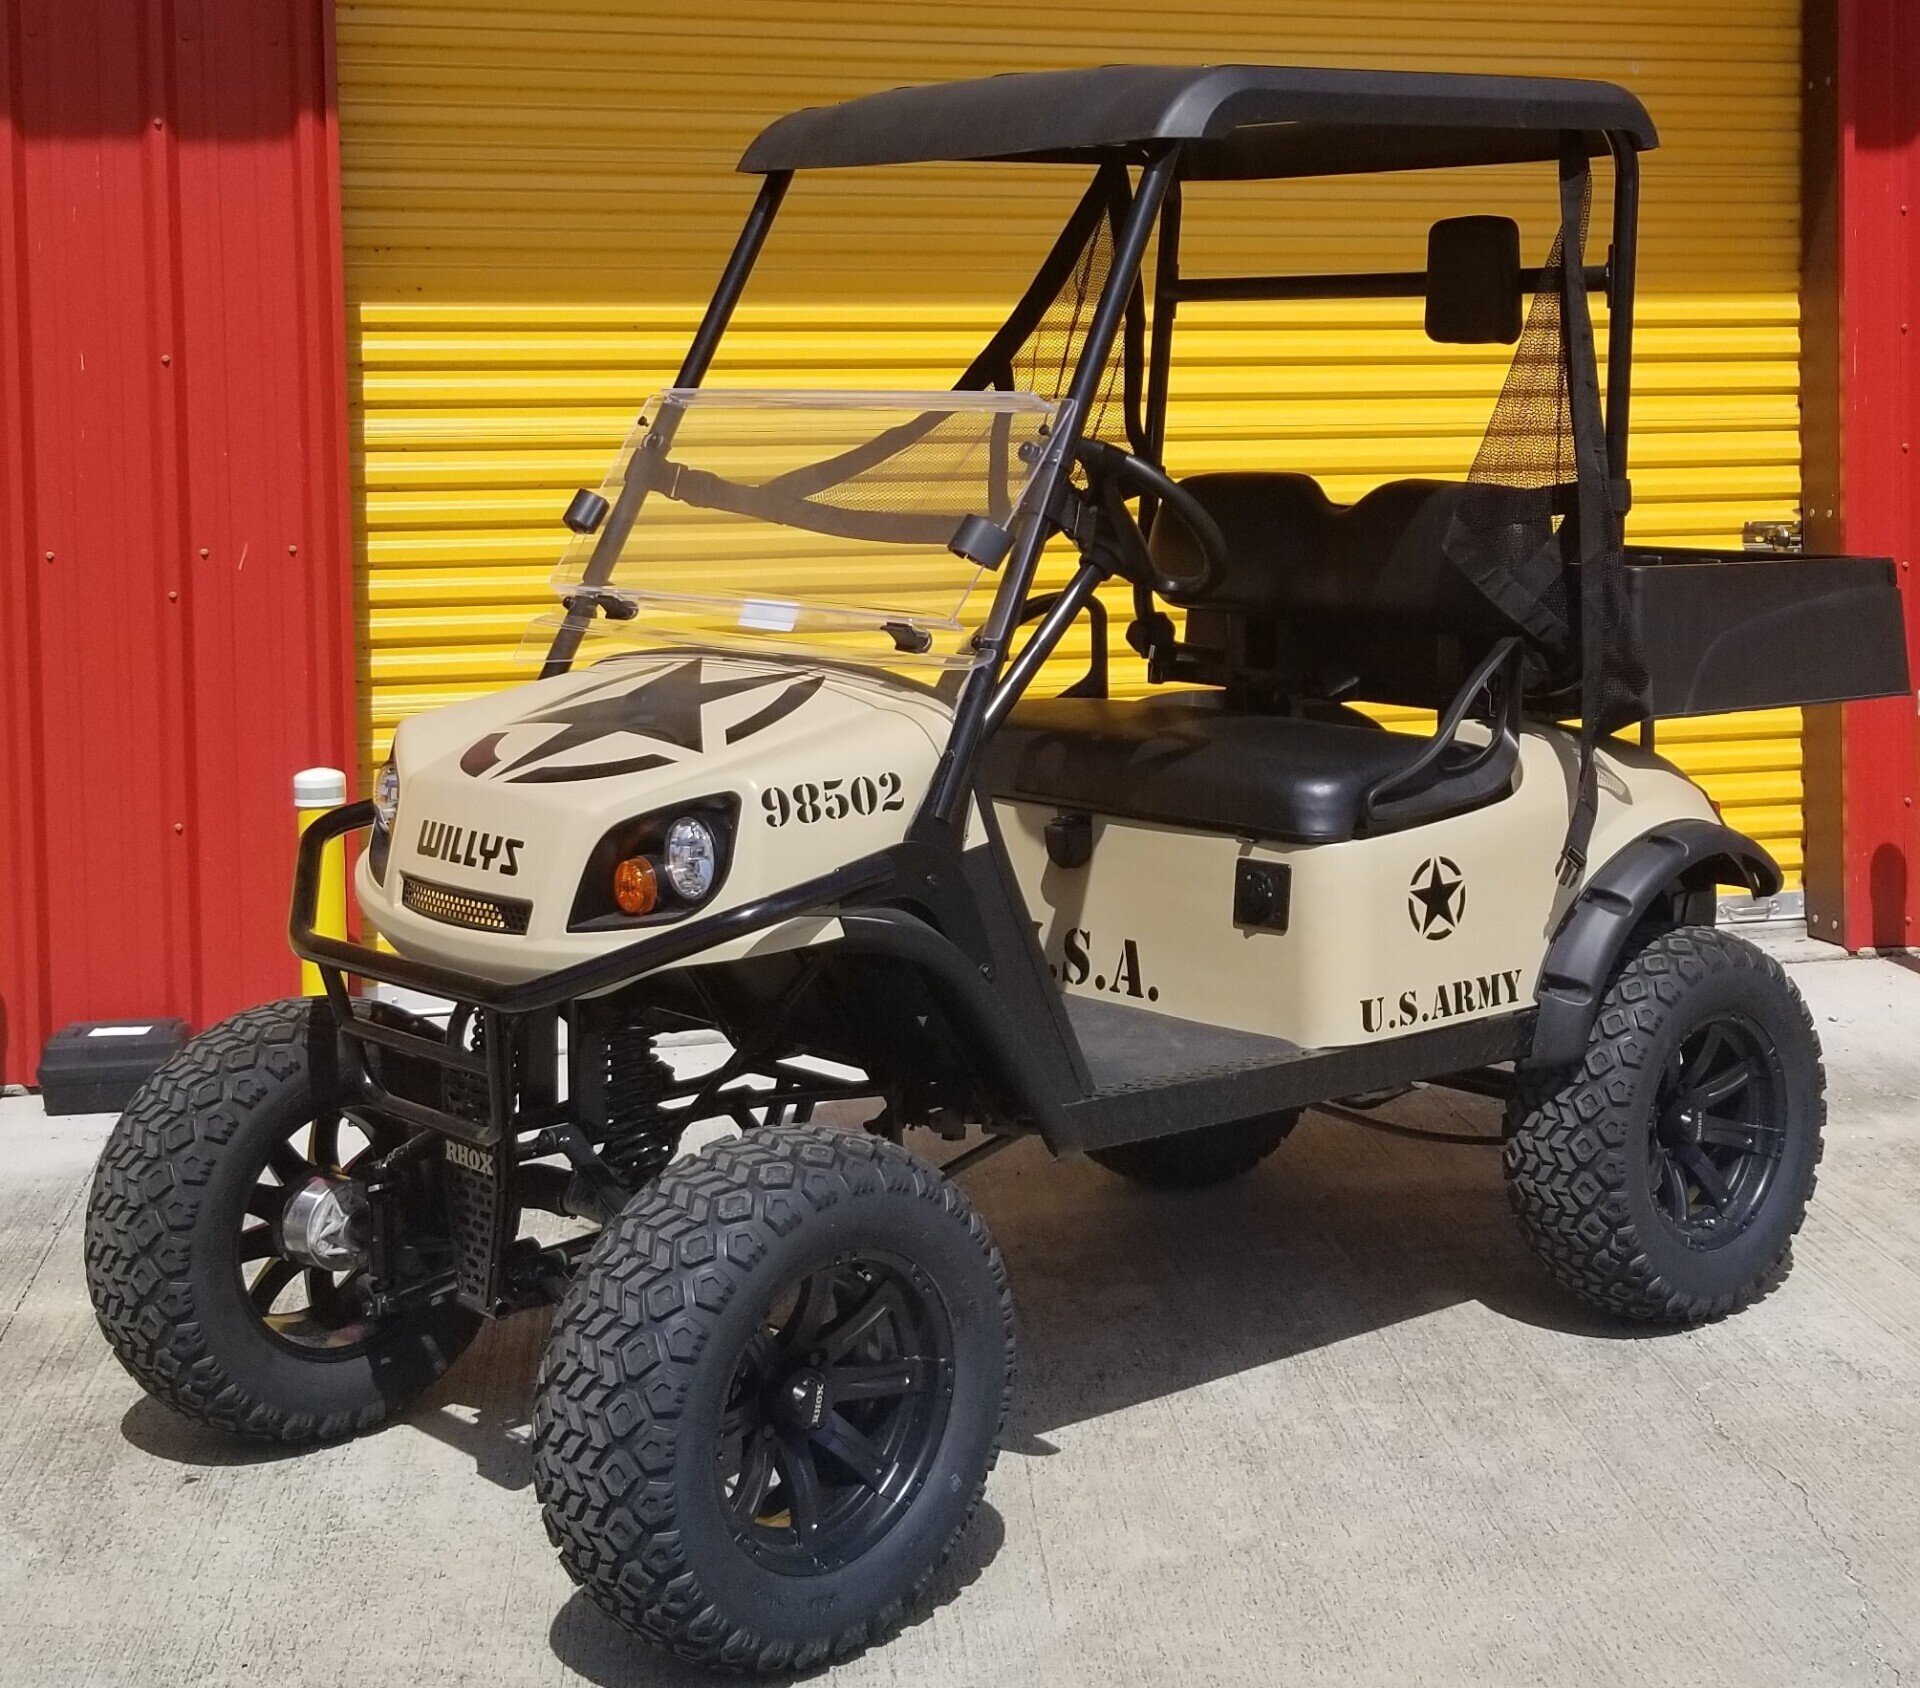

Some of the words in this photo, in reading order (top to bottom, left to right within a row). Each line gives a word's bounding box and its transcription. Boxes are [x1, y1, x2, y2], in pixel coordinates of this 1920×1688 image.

[761, 772, 905, 828] 98502
[416, 819, 525, 876] WILLYS
[1031, 920, 1159, 1002] .S.A.
[445, 1139, 494, 1176] RHOX
